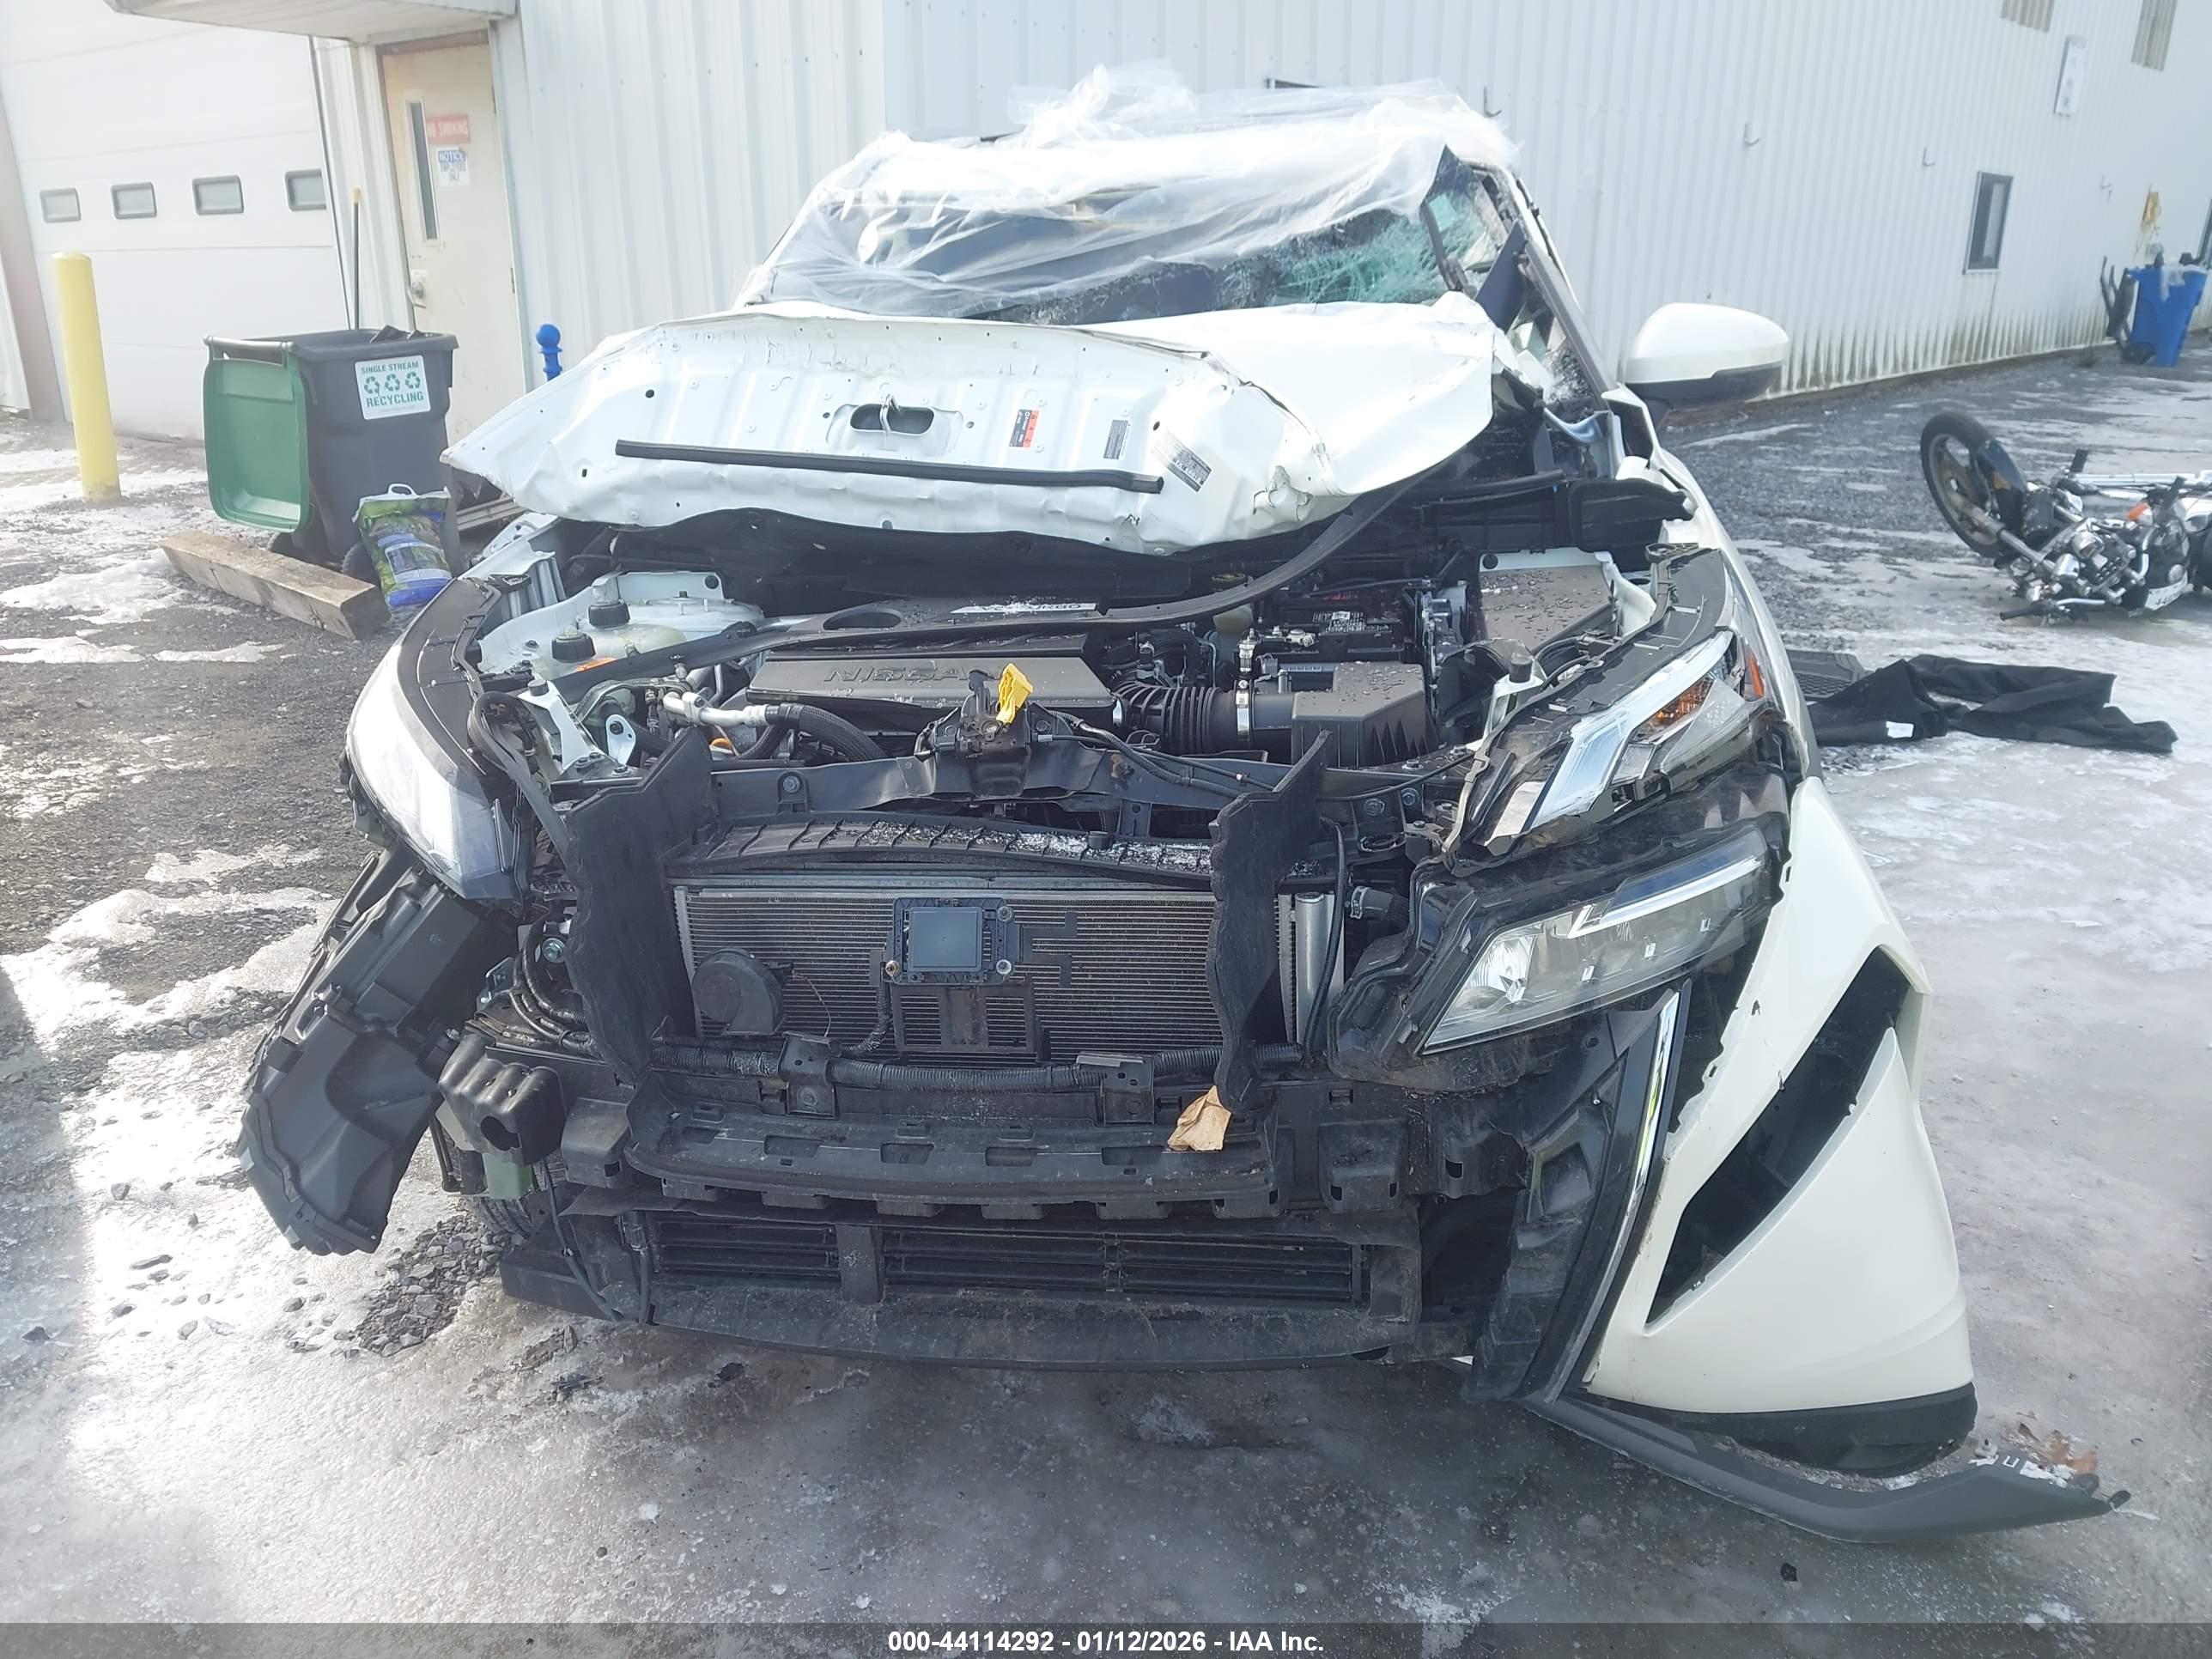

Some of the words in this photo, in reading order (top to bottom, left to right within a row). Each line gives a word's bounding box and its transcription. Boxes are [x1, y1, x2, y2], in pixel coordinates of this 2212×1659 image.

[362, 364, 386, 374] SINGLE
[388, 361, 419, 371] STREAM
[366, 391, 424, 408] RECYCLING
